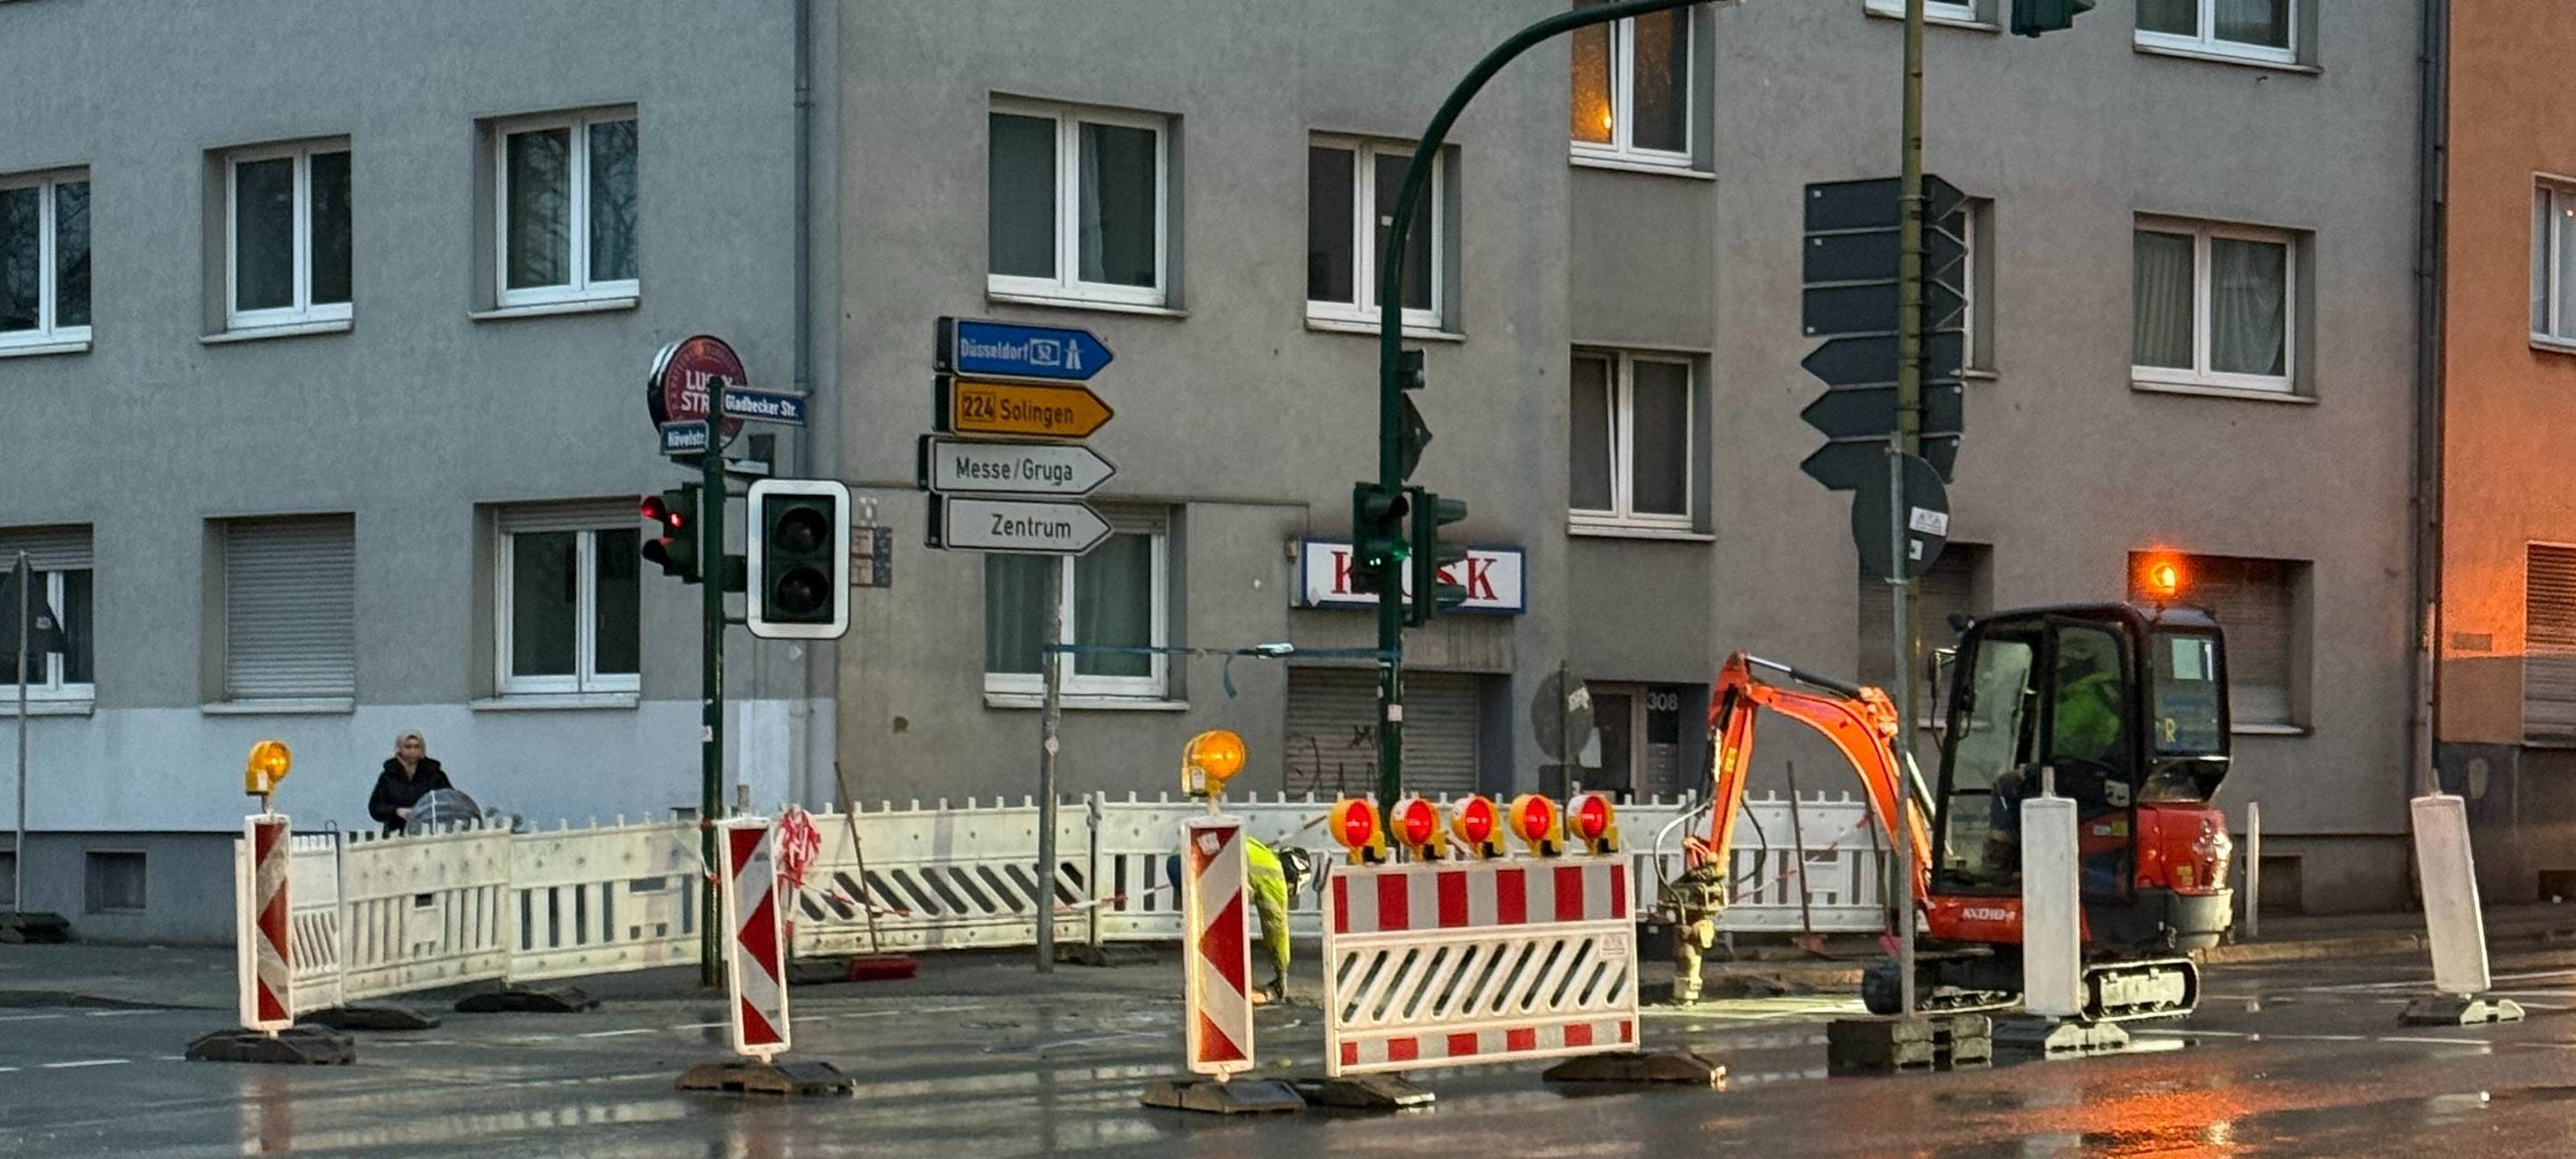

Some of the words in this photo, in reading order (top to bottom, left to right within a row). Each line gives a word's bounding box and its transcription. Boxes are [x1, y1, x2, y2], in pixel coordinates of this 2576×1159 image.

[959, 336, 1029, 361] Düsseldorf
[1037, 341, 1052, 361] 52
[725, 394, 779, 415] Gladbecker
[780, 399, 798, 417] Str.
[964, 394, 994, 419] 224
[999, 398, 1074, 428] Solingen
[956, 456, 1073, 486] Messe/Gruga
[991, 513, 1072, 539] Zentrum
[1646, 692, 1679, 711] 308
